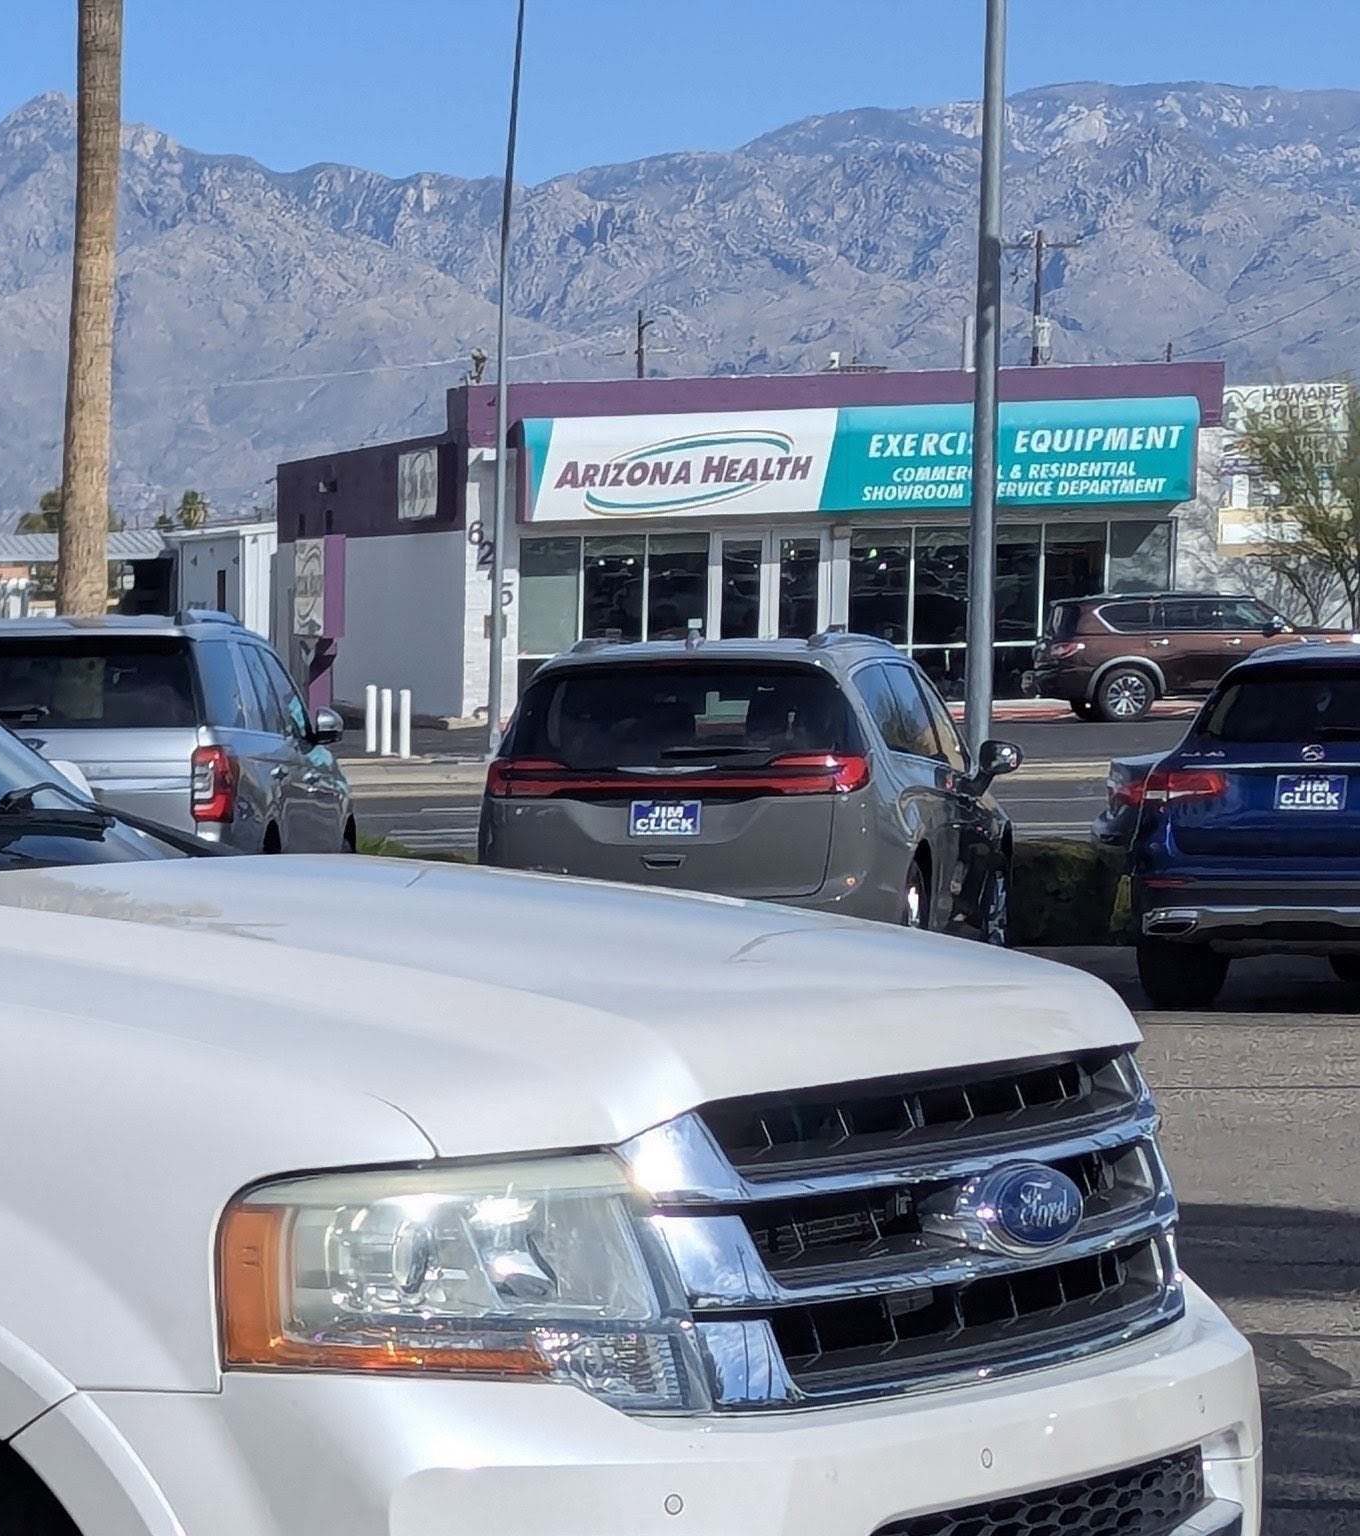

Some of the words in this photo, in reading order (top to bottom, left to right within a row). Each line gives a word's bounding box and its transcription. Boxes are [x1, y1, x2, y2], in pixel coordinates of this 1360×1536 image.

[1262, 386, 1346, 402] HUMANE
[868, 431, 973, 458] EXERCI
[1013, 425, 1185, 454] EQUIPMENT
[553, 456, 692, 489] ARIZONA
[700, 455, 814, 484] HEALTH
[892, 464, 1005, 483] COMMERL
[1009, 464, 1021, 480] &
[1027, 461, 1137, 480] RESIDENTIAL
[862, 483, 964, 502] SHOWROOM
[995, 479, 1052, 498] ERVICE
[1057, 477, 1168, 496] DEPARTMENT
[1294, 780, 1330, 792] JIM
[1280, 792, 1340, 805] CLICK
[648, 806, 684, 818] JIM
[635, 818, 694, 831] CLICK
[1019, 1180, 1072, 1228] Ford
